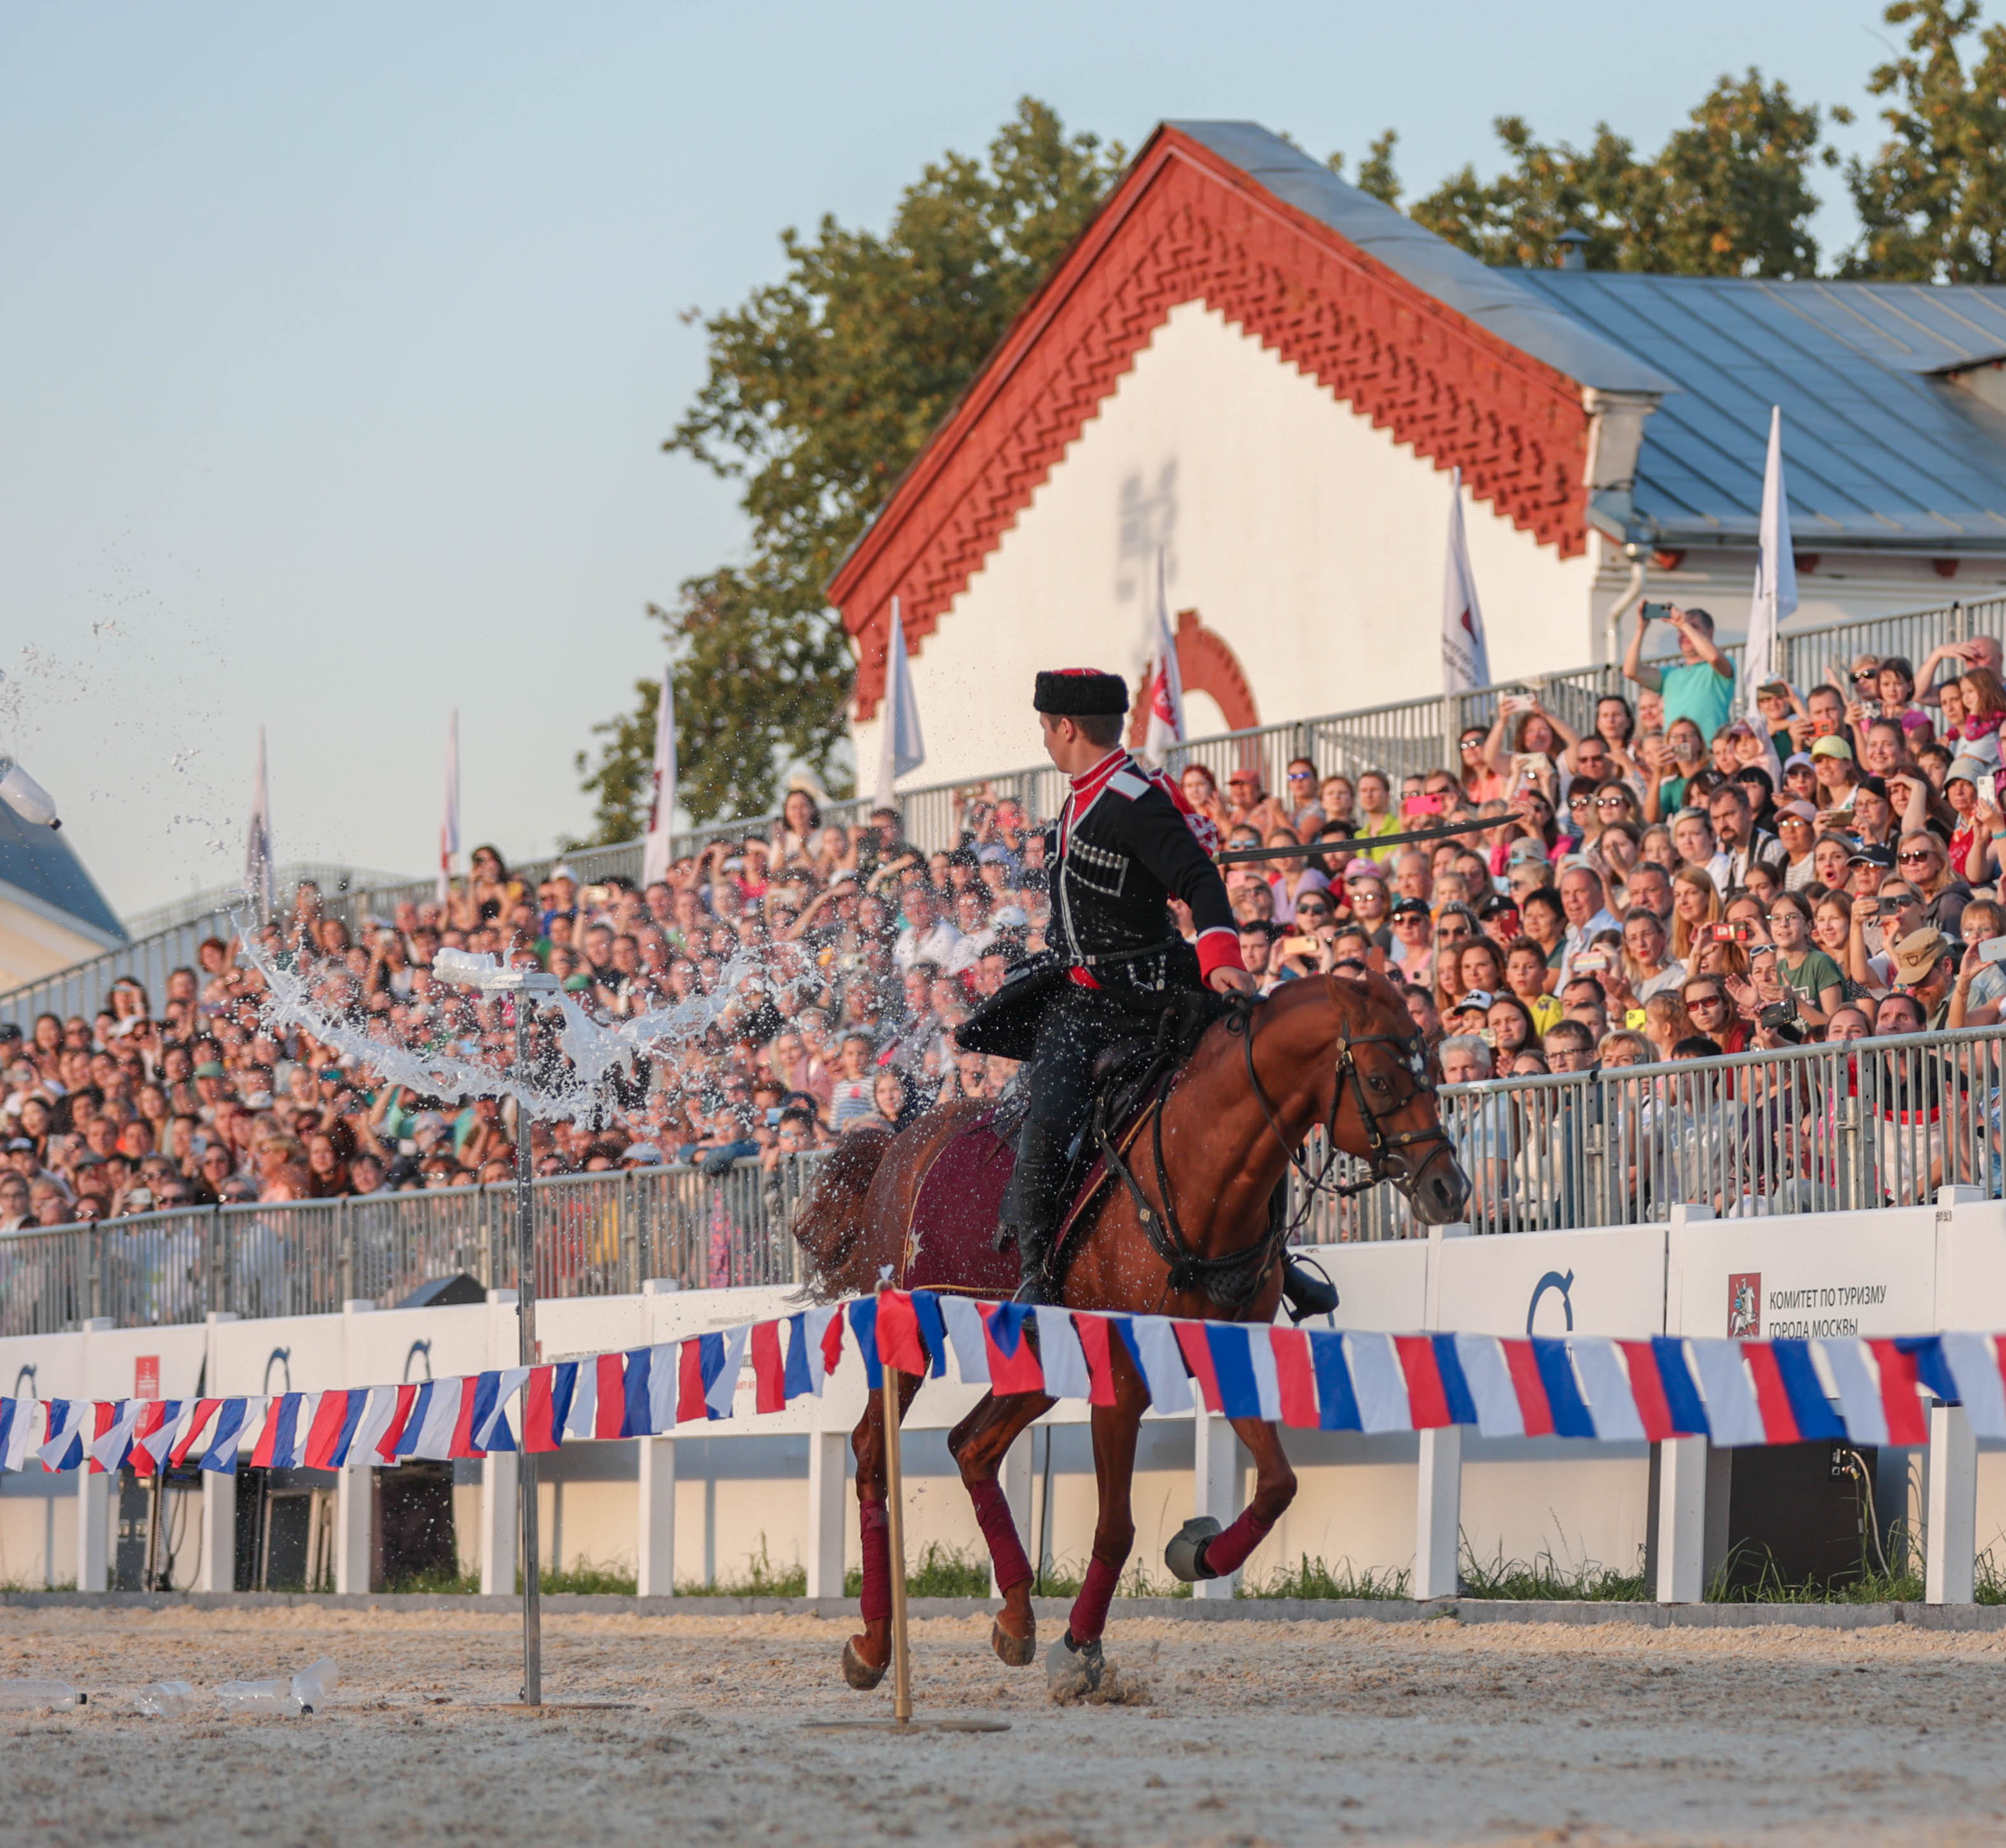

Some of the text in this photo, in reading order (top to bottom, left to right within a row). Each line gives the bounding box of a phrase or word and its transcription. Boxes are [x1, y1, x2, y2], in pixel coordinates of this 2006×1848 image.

[1769, 1285, 1887, 1310] КОМИТЕТ ПО ТУРИЗМУ
[1769, 1317, 1858, 1339] ГОРОДА МОСКВЫ
